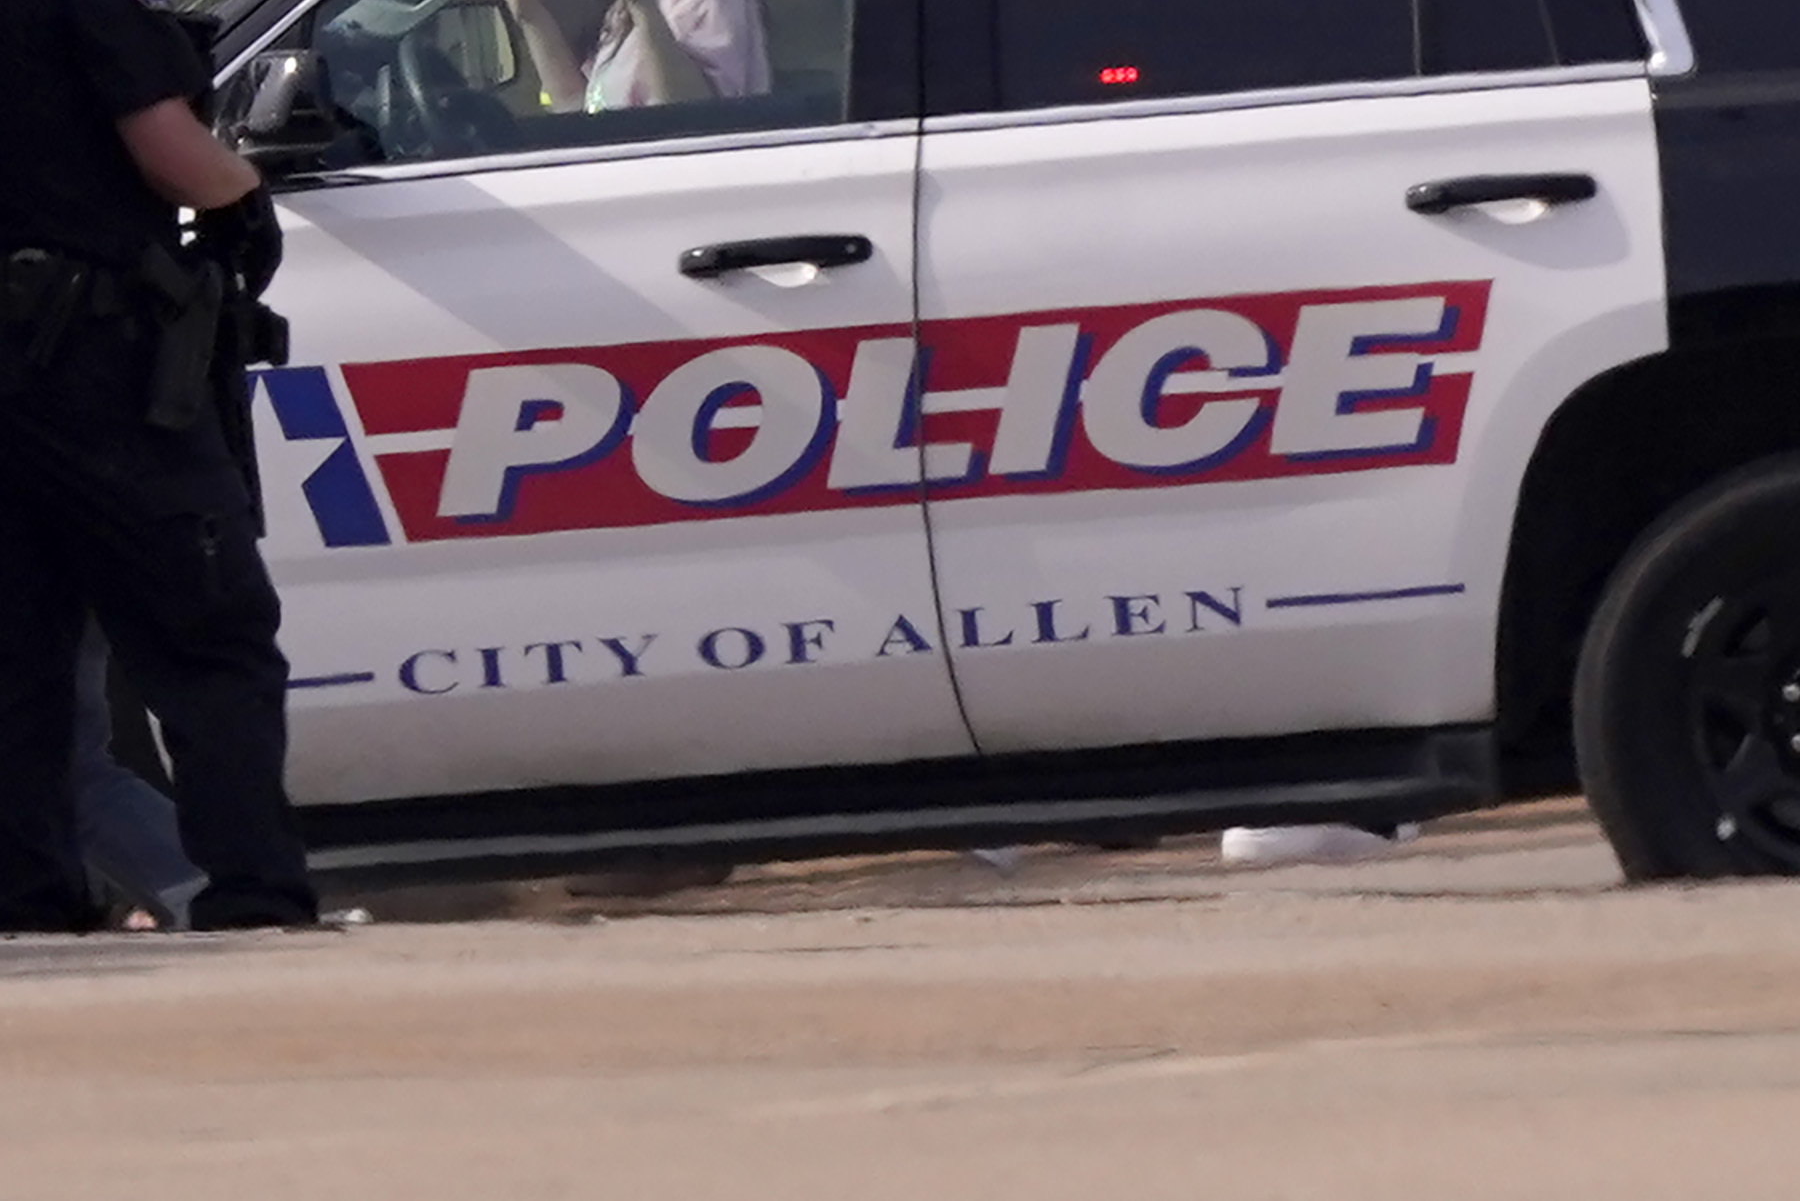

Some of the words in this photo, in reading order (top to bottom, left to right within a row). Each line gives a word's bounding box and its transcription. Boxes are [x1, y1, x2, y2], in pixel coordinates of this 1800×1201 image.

[437, 297, 1457, 525] POLICE
[398, 633, 659, 695] CITY
[697, 619, 836, 670] OF
[877, 587, 1246, 657] ALLEN
